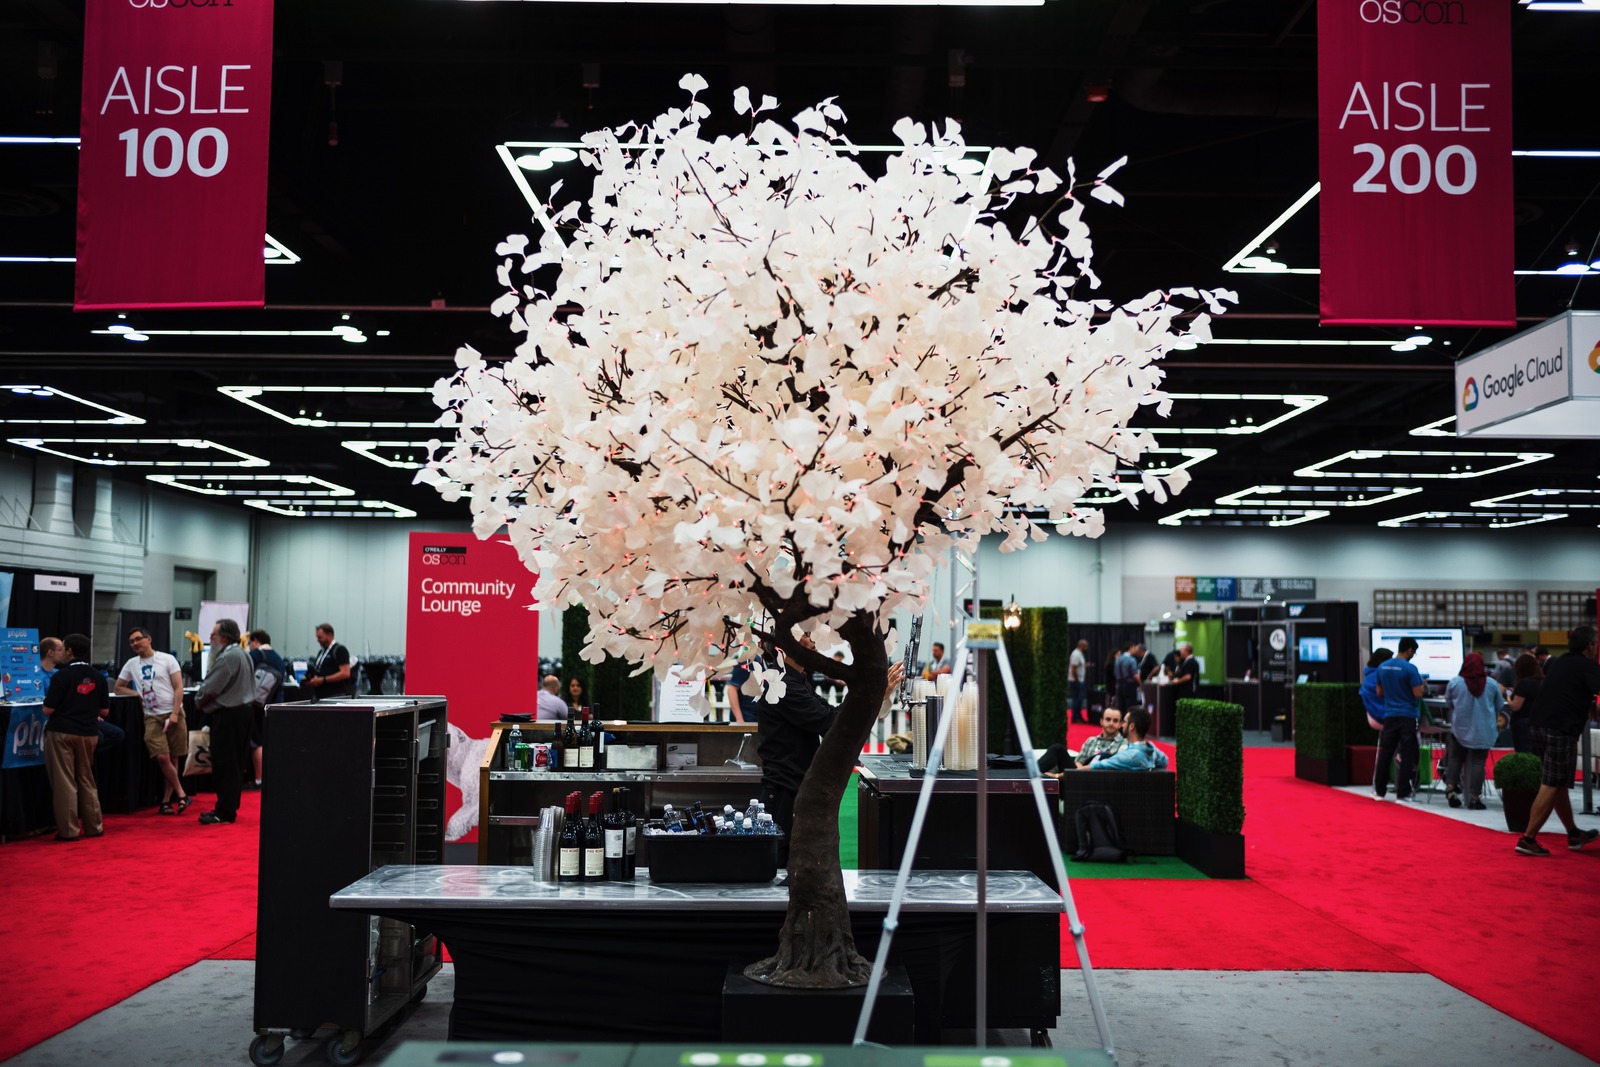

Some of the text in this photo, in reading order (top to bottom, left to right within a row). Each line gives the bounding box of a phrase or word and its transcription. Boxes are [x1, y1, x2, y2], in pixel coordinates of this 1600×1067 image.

[100, 64, 252, 115] AISLE
[1338, 81, 1491, 132] AISLE
[118, 127, 229, 178] 100
[1352, 142, 1478, 195] 200
[1482, 347, 1563, 399] Google Cloud
[421, 578, 516, 599] Community
[421, 596, 482, 616] Lounge
